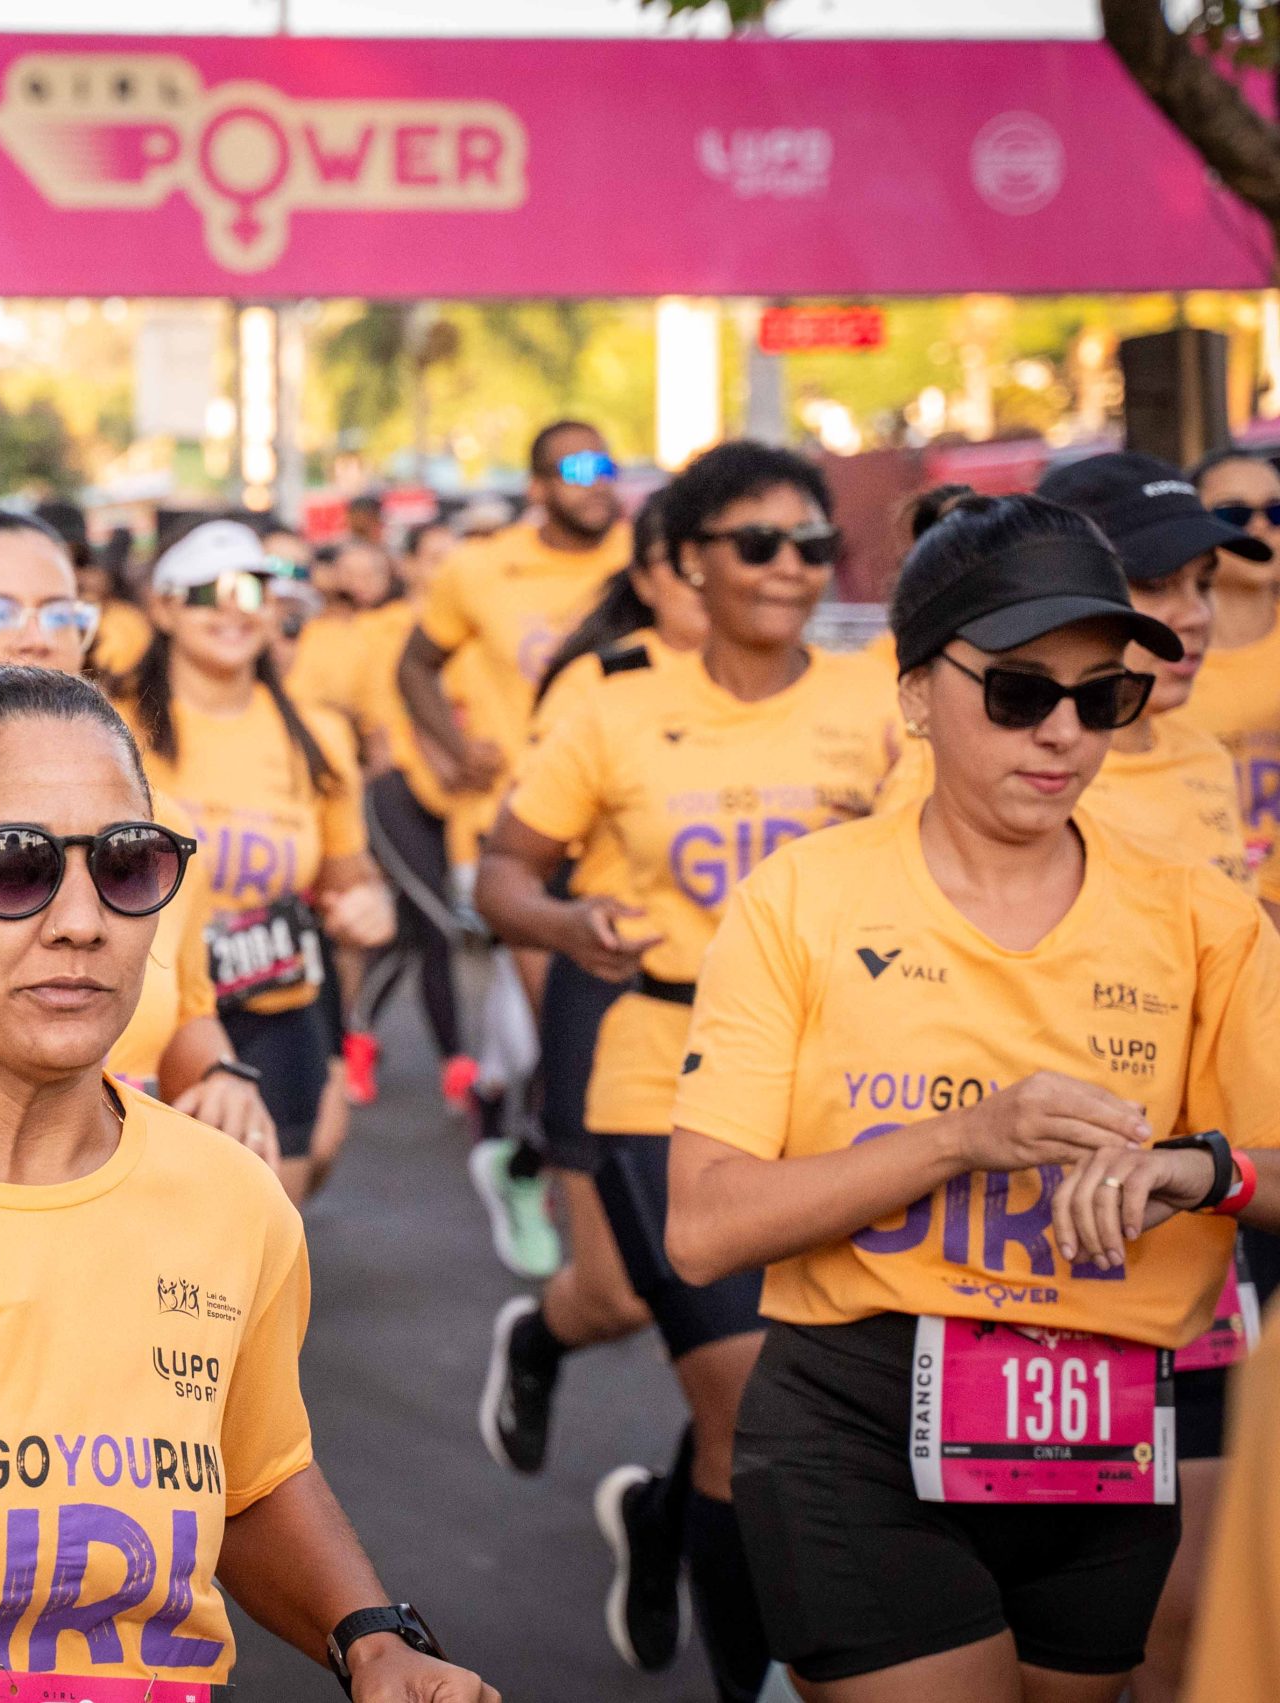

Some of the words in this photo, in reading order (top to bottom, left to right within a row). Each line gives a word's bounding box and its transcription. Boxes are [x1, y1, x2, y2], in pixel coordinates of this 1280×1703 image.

[901, 964, 949, 984] VALE
[1088, 1035, 1157, 1061] LUPO
[153, 1346, 219, 1382] LUPO
[914, 1353, 933, 1458] BRANCO
[1002, 1357, 1111, 1442] 1361
[1033, 1445, 1072, 1461] CINTIA
[43, 1690, 78, 1700] GIRL
